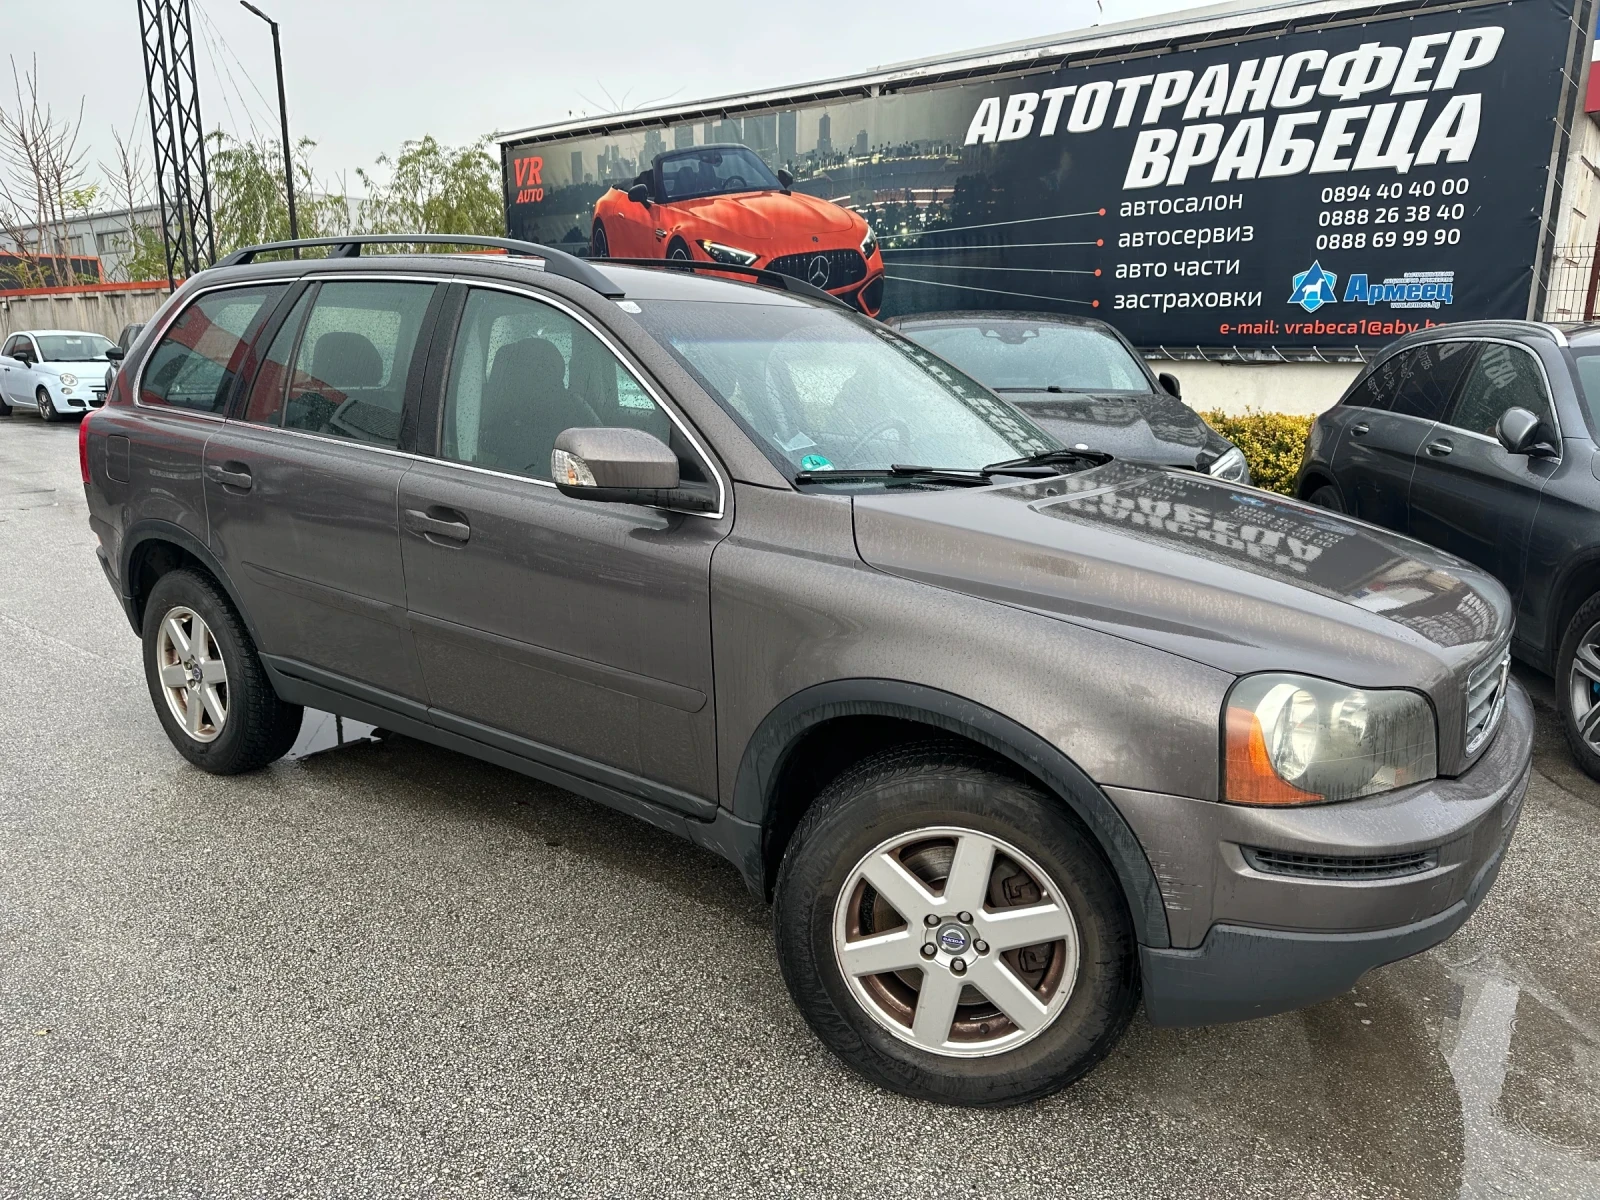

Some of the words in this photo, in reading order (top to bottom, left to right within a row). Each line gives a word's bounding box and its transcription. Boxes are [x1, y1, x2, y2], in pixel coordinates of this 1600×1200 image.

[963, 26, 1506, 147] АВТОТРАНСФЕР
[1122, 92, 1482, 191] ВРАБЕЦА
[513, 156, 544, 188] VR
[515, 187, 544, 204] AUTO
[1321, 184, 1371, 204] 0894
[1376, 182, 1403, 200] 40
[1408, 180, 1436, 198] 40
[1441, 177, 1469, 196] 00
[1119, 193, 1244, 217] автосалон
[1318, 208, 1369, 227] 0888
[1374, 206, 1400, 224] 26
[1404, 205, 1431, 223] 38
[1436, 203, 1465, 221] 40
[1118, 225, 1254, 250] автосервиз
[1316, 232, 1367, 250] 0888
[1372, 231, 1397, 248] 69
[1402, 229, 1428, 247] 99
[1433, 228, 1461, 246] 90
[1115, 261, 1168, 279] авто
[1173, 258, 1241, 277] части
[1342, 273, 1453, 305] Армеец
[1113, 291, 1263, 314] застраховки
[1219, 319, 1280, 335] e-mail:
